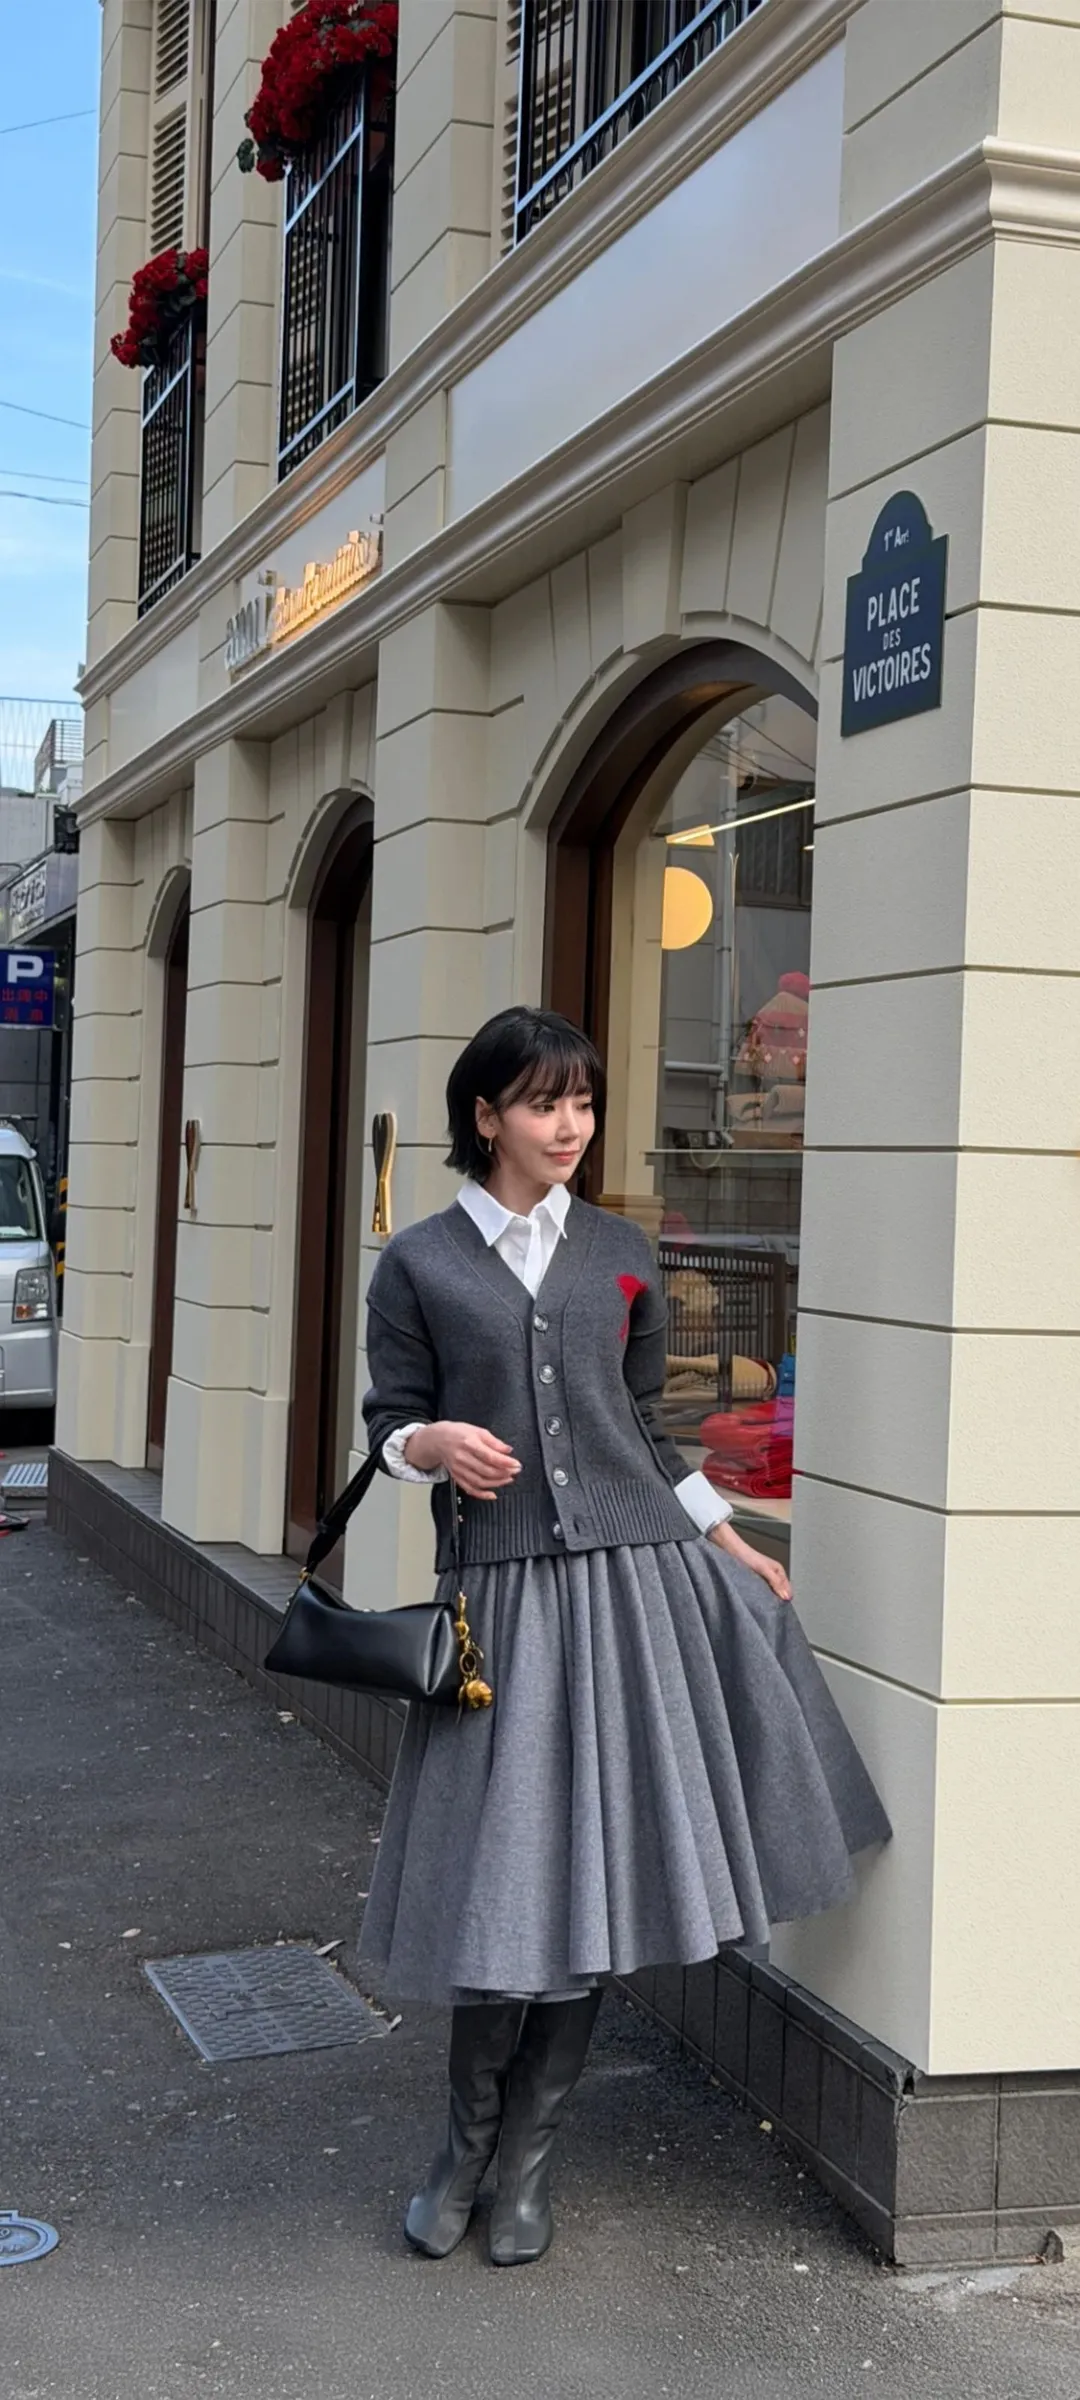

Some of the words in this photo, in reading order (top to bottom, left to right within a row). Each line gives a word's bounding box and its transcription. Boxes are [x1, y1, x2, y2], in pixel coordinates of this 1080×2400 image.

[867, 577, 921, 632] PLACE
[883, 628, 901, 650] DES
[853, 643, 931, 702] VICTOIRES
[8, 954, 43, 983] P
